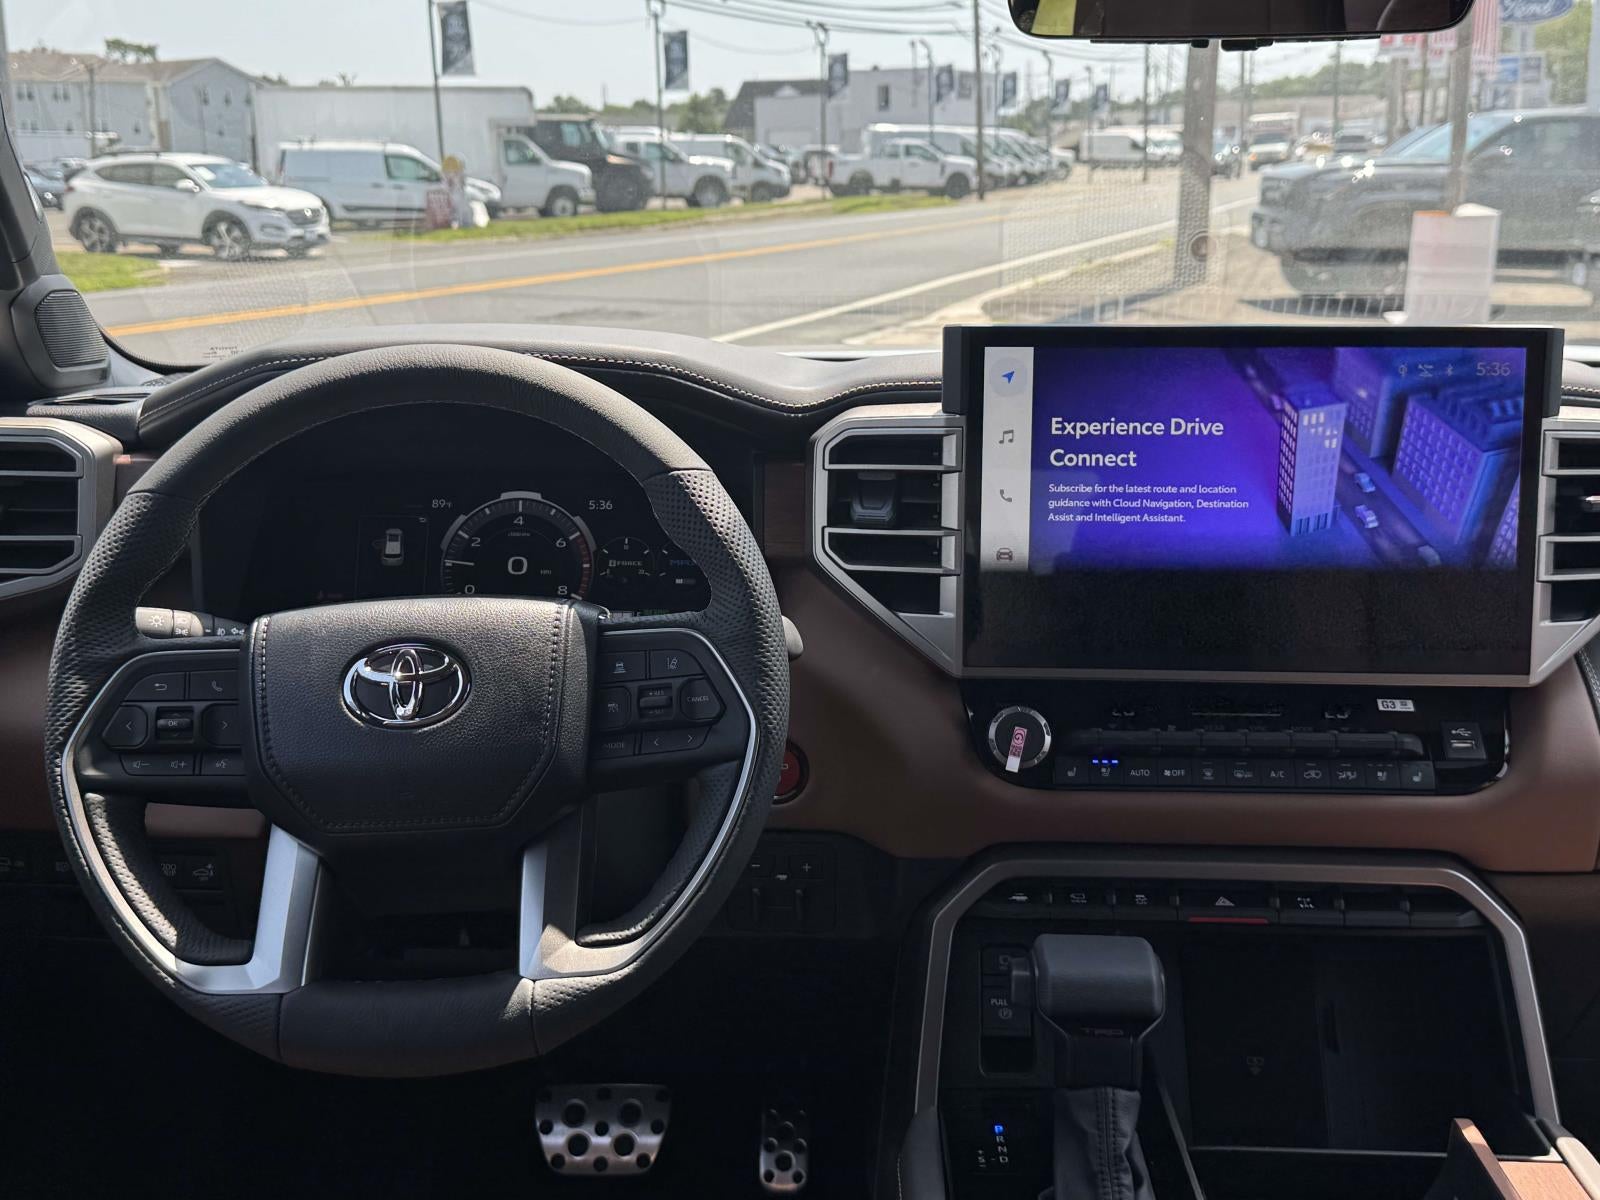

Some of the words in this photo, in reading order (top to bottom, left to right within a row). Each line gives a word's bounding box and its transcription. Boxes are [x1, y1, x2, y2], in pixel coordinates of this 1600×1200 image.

[1475, 362, 1512, 377] 5:36
[1051, 417, 1165, 439] Experience
[1170, 417, 1225, 436] Drive
[1050, 449, 1137, 467] Connect
[1048, 483, 1093, 493] Subscribe
[1094, 483, 1107, 493] for
[1108, 484, 1124, 493] the
[1125, 484, 1152, 493] latest
[1153, 485, 1178, 493] route
[1179, 485, 1198, 493] and
[1199, 485, 1237, 494] location
[588, 500, 613, 511] 5:36
[1048, 498, 1091, 509] guidance
[1091, 499, 1112, 508] with
[1112, 499, 1141, 508] Cloud
[1142, 499, 1194, 510] Navigation,
[1196, 499, 1249, 509] Destination
[513, 515, 524, 527] 4
[1047, 512, 1074, 522] Assist
[1075, 513, 1093, 522] and
[1094, 513, 1141, 524] Intelligent
[1142, 513, 1186, 522] Assistant.
[471, 537, 481, 547] 2
[555, 537, 567, 548] 6
[507, 556, 528, 576] 0
[464, 584, 476, 595] 0
[556, 585, 568, 596] 8
[1381, 699, 1397, 710] G3
[167, 719, 179, 727] OK
[1130, 769, 1150, 777] AUTO
[1172, 769, 1185, 777] OFF
[1270, 770, 1285, 779] A/C
[990, 998, 1009, 1007] PULL
